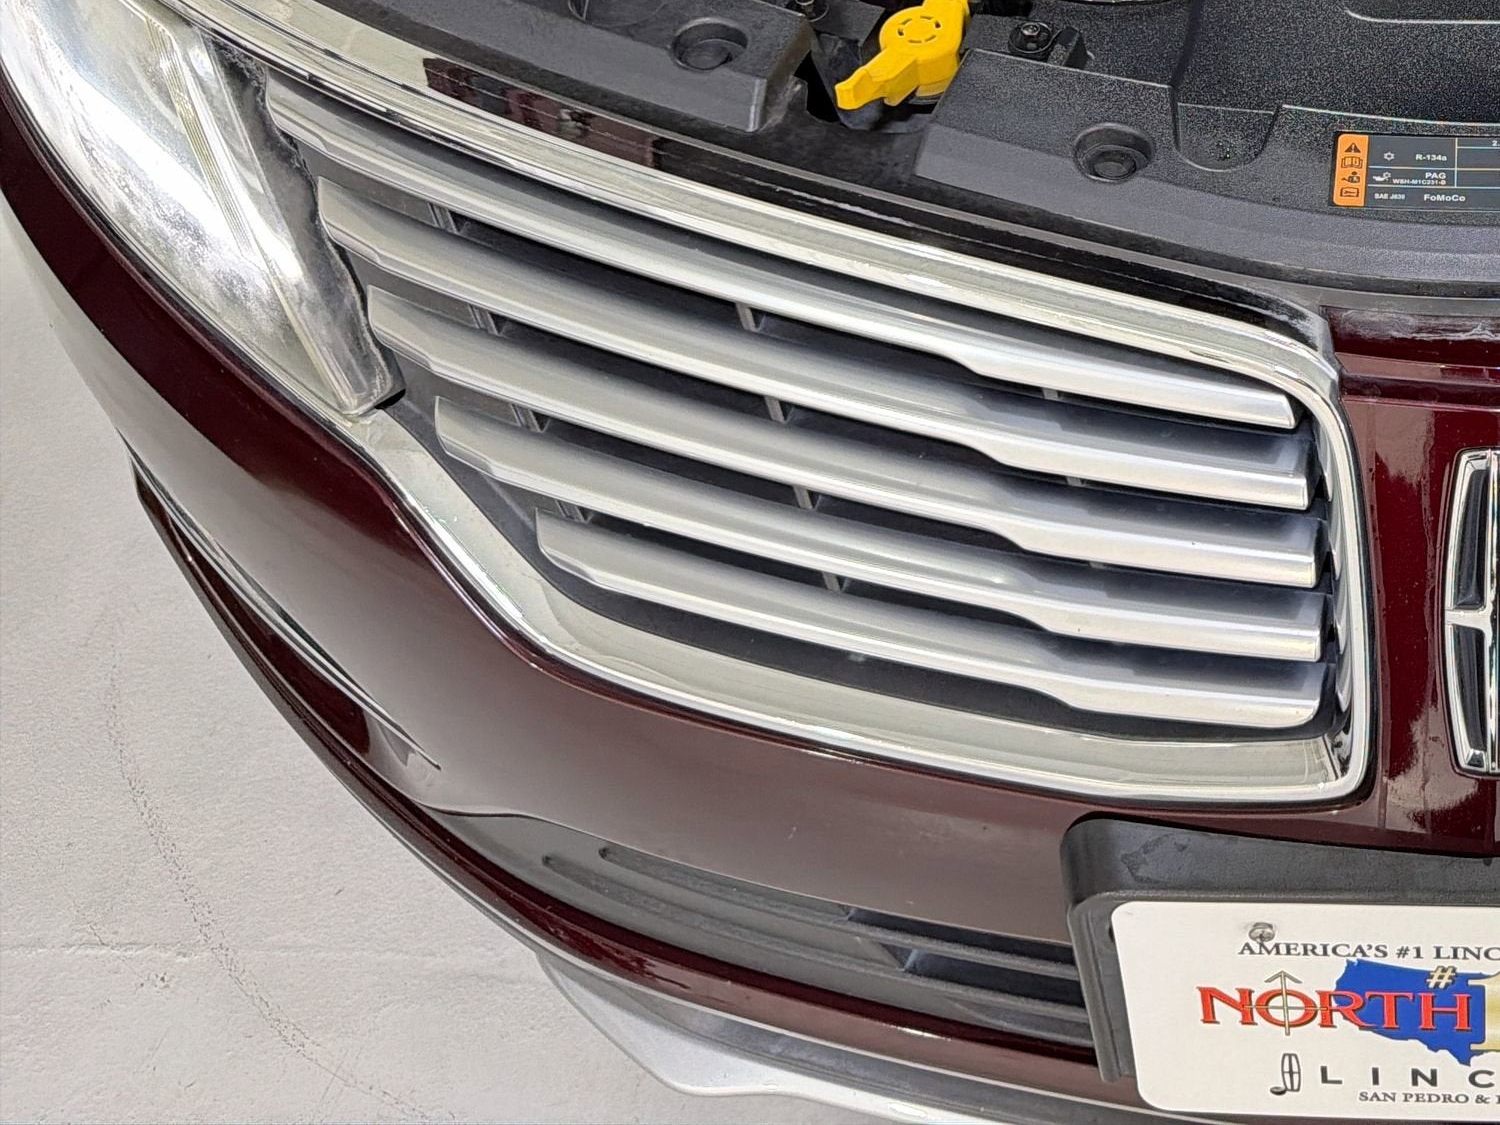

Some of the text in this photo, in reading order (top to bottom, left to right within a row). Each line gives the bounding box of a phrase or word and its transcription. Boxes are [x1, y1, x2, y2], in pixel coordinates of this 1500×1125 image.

[1415, 153, 1448, 162] R-134a
[1423, 193, 1466, 202] FoMoCo
[1237, 941, 1389, 959] AMERICA'S
[1396, 945, 1424, 960] #1
[1196, 985, 1472, 1032] NORTH
[1358, 1091, 1397, 1103] SAN
[1402, 1092, 1469, 1104] PEDRO
[1474, 1093, 1492, 1105] &
